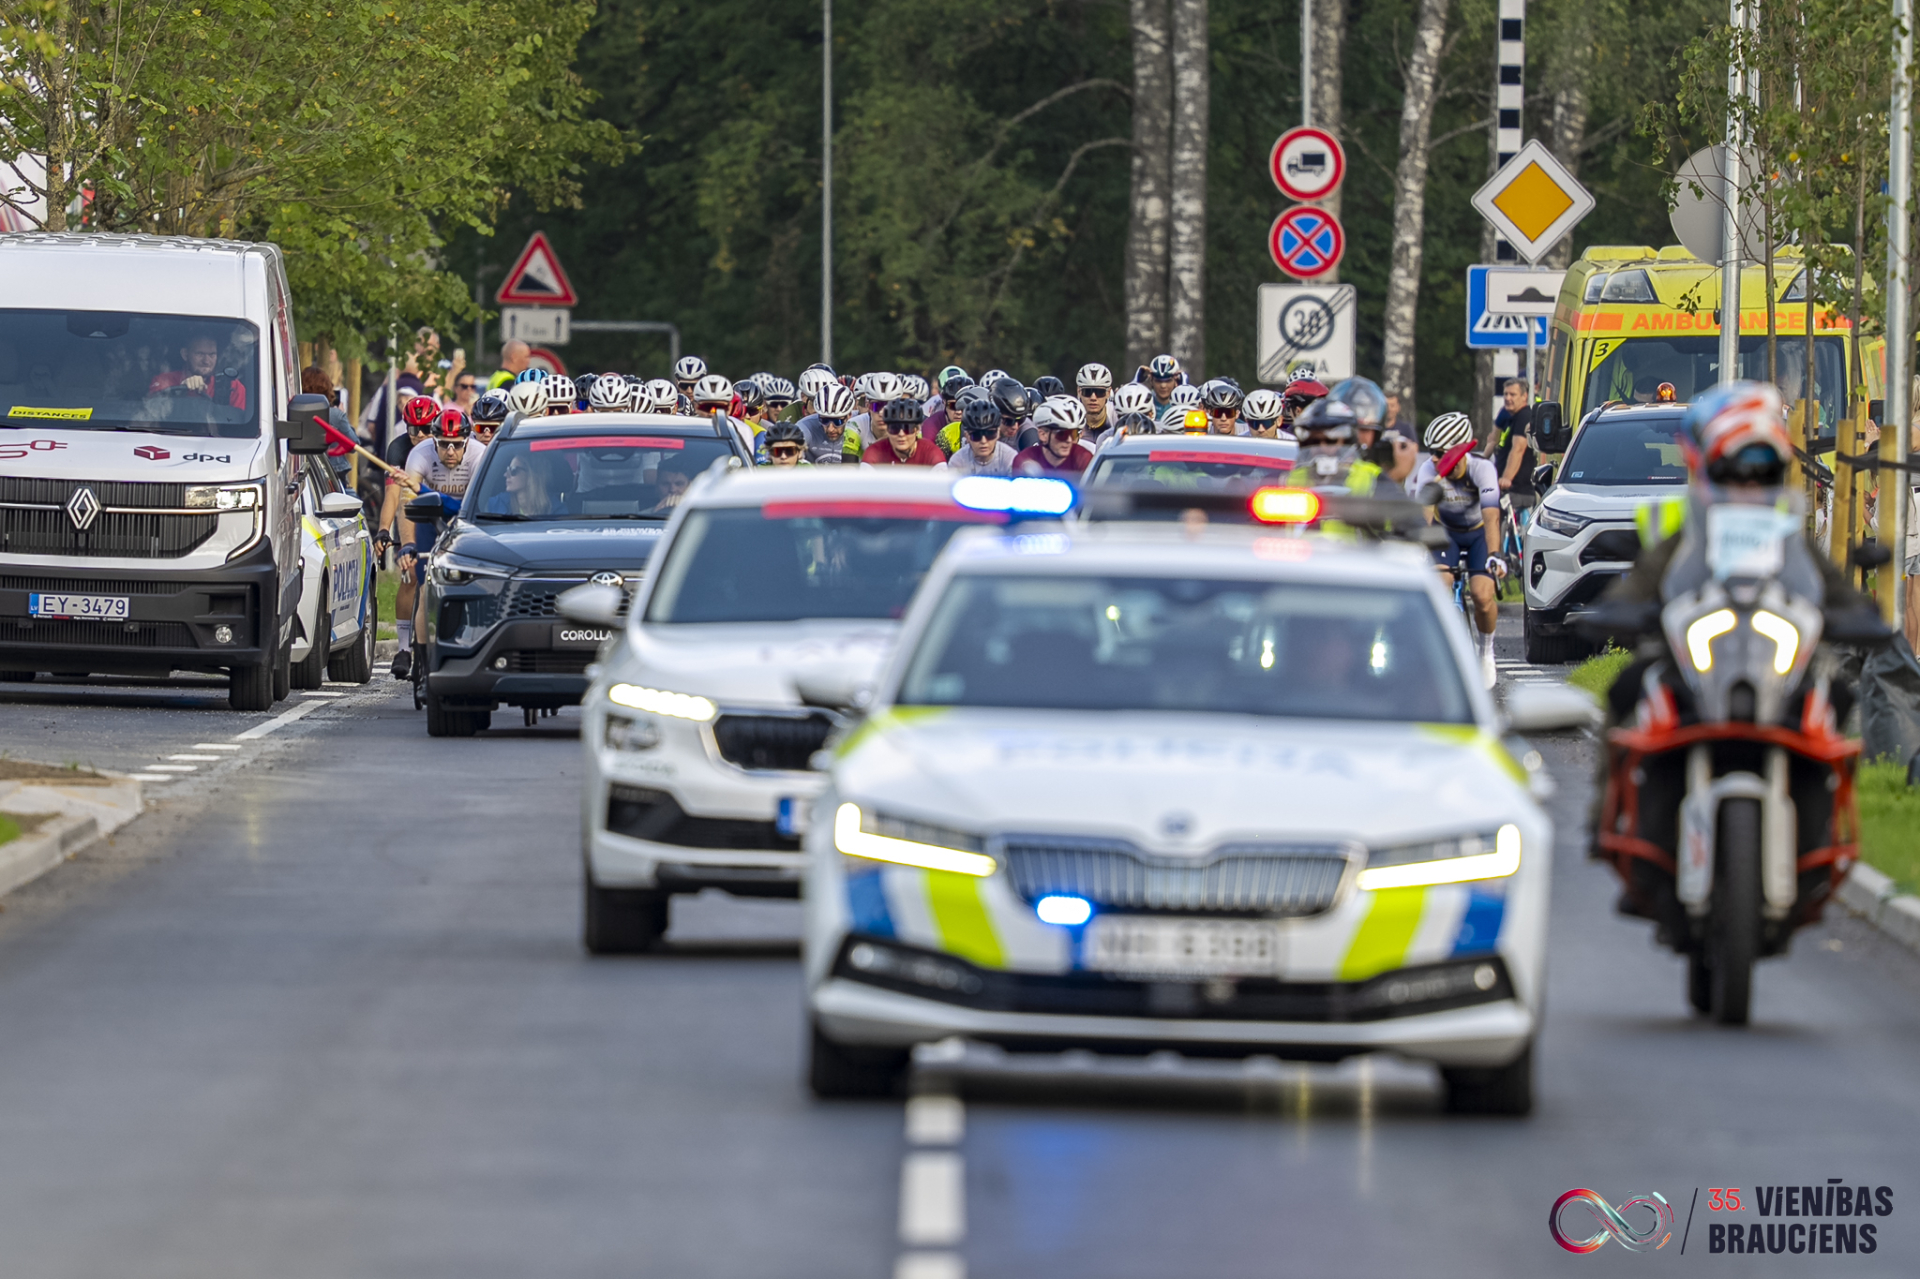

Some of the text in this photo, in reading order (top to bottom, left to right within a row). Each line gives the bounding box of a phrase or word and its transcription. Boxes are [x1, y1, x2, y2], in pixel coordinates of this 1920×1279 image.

[1595, 342, 1610, 358] 3
[13, 410, 87, 419] DISTANCES
[182, 453, 231, 463] dpd
[43, 596, 126, 615] EY-3479
[560, 629, 614, 641] COROLLA
